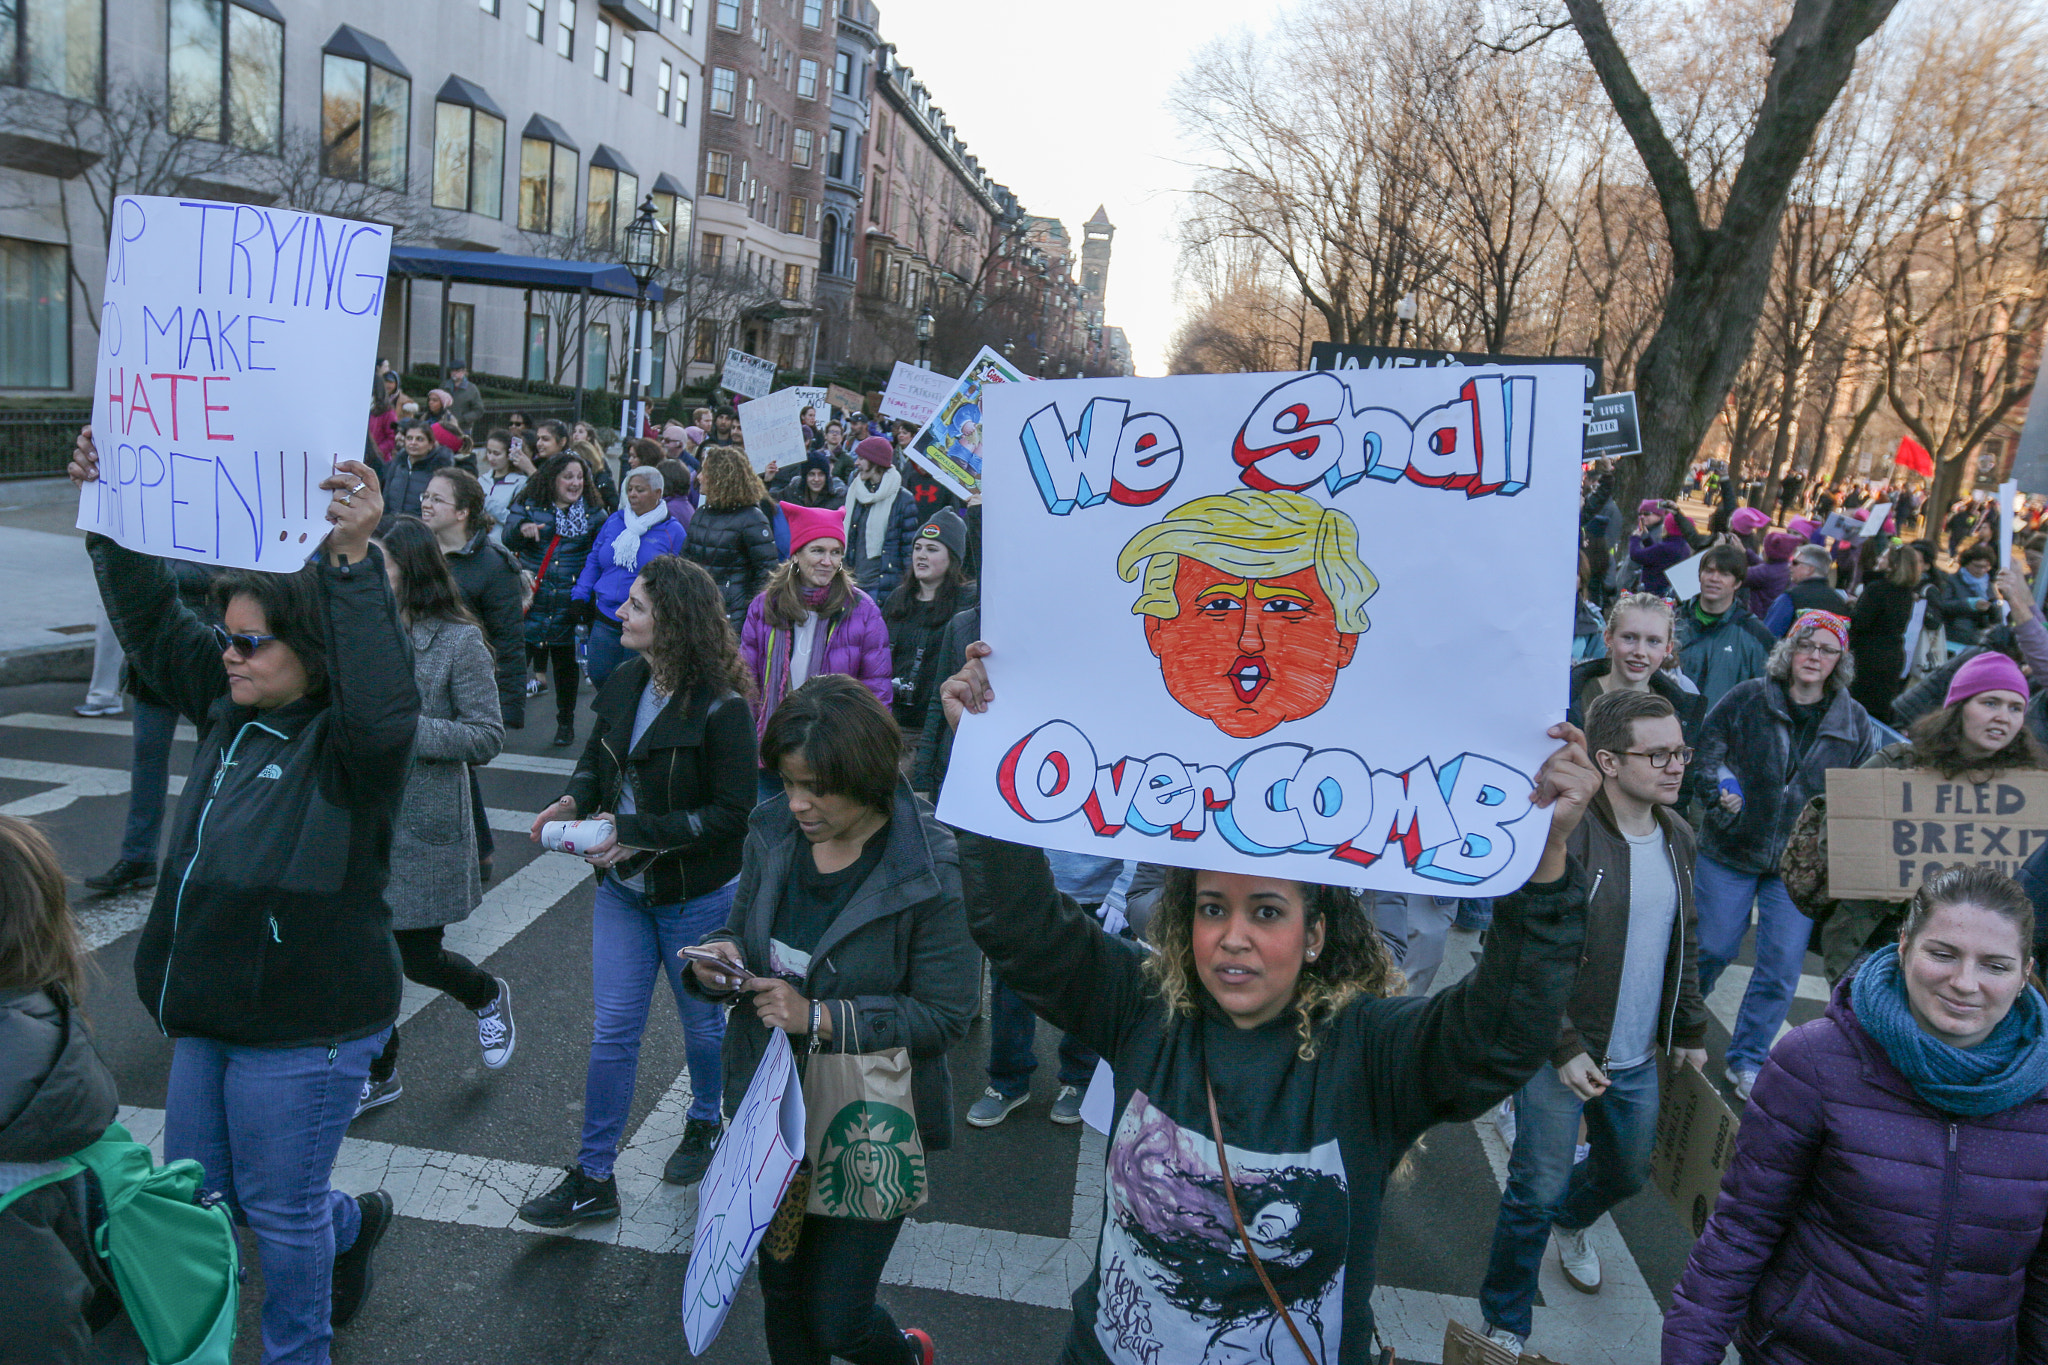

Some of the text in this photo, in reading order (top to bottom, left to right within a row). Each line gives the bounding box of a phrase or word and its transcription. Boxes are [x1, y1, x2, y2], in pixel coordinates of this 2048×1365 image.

[179, 202, 385, 316] TRYING
[143, 303, 286, 372] MAKE
[108, 366, 235, 441] HATE
[899, 367, 949, 389] PROTEST
[1590, 421, 1616, 434] ATTER
[1600, 403, 1625, 416] LIVES
[1018, 371, 1538, 517] We Shall
[1902, 781, 2026, 816] I FLED
